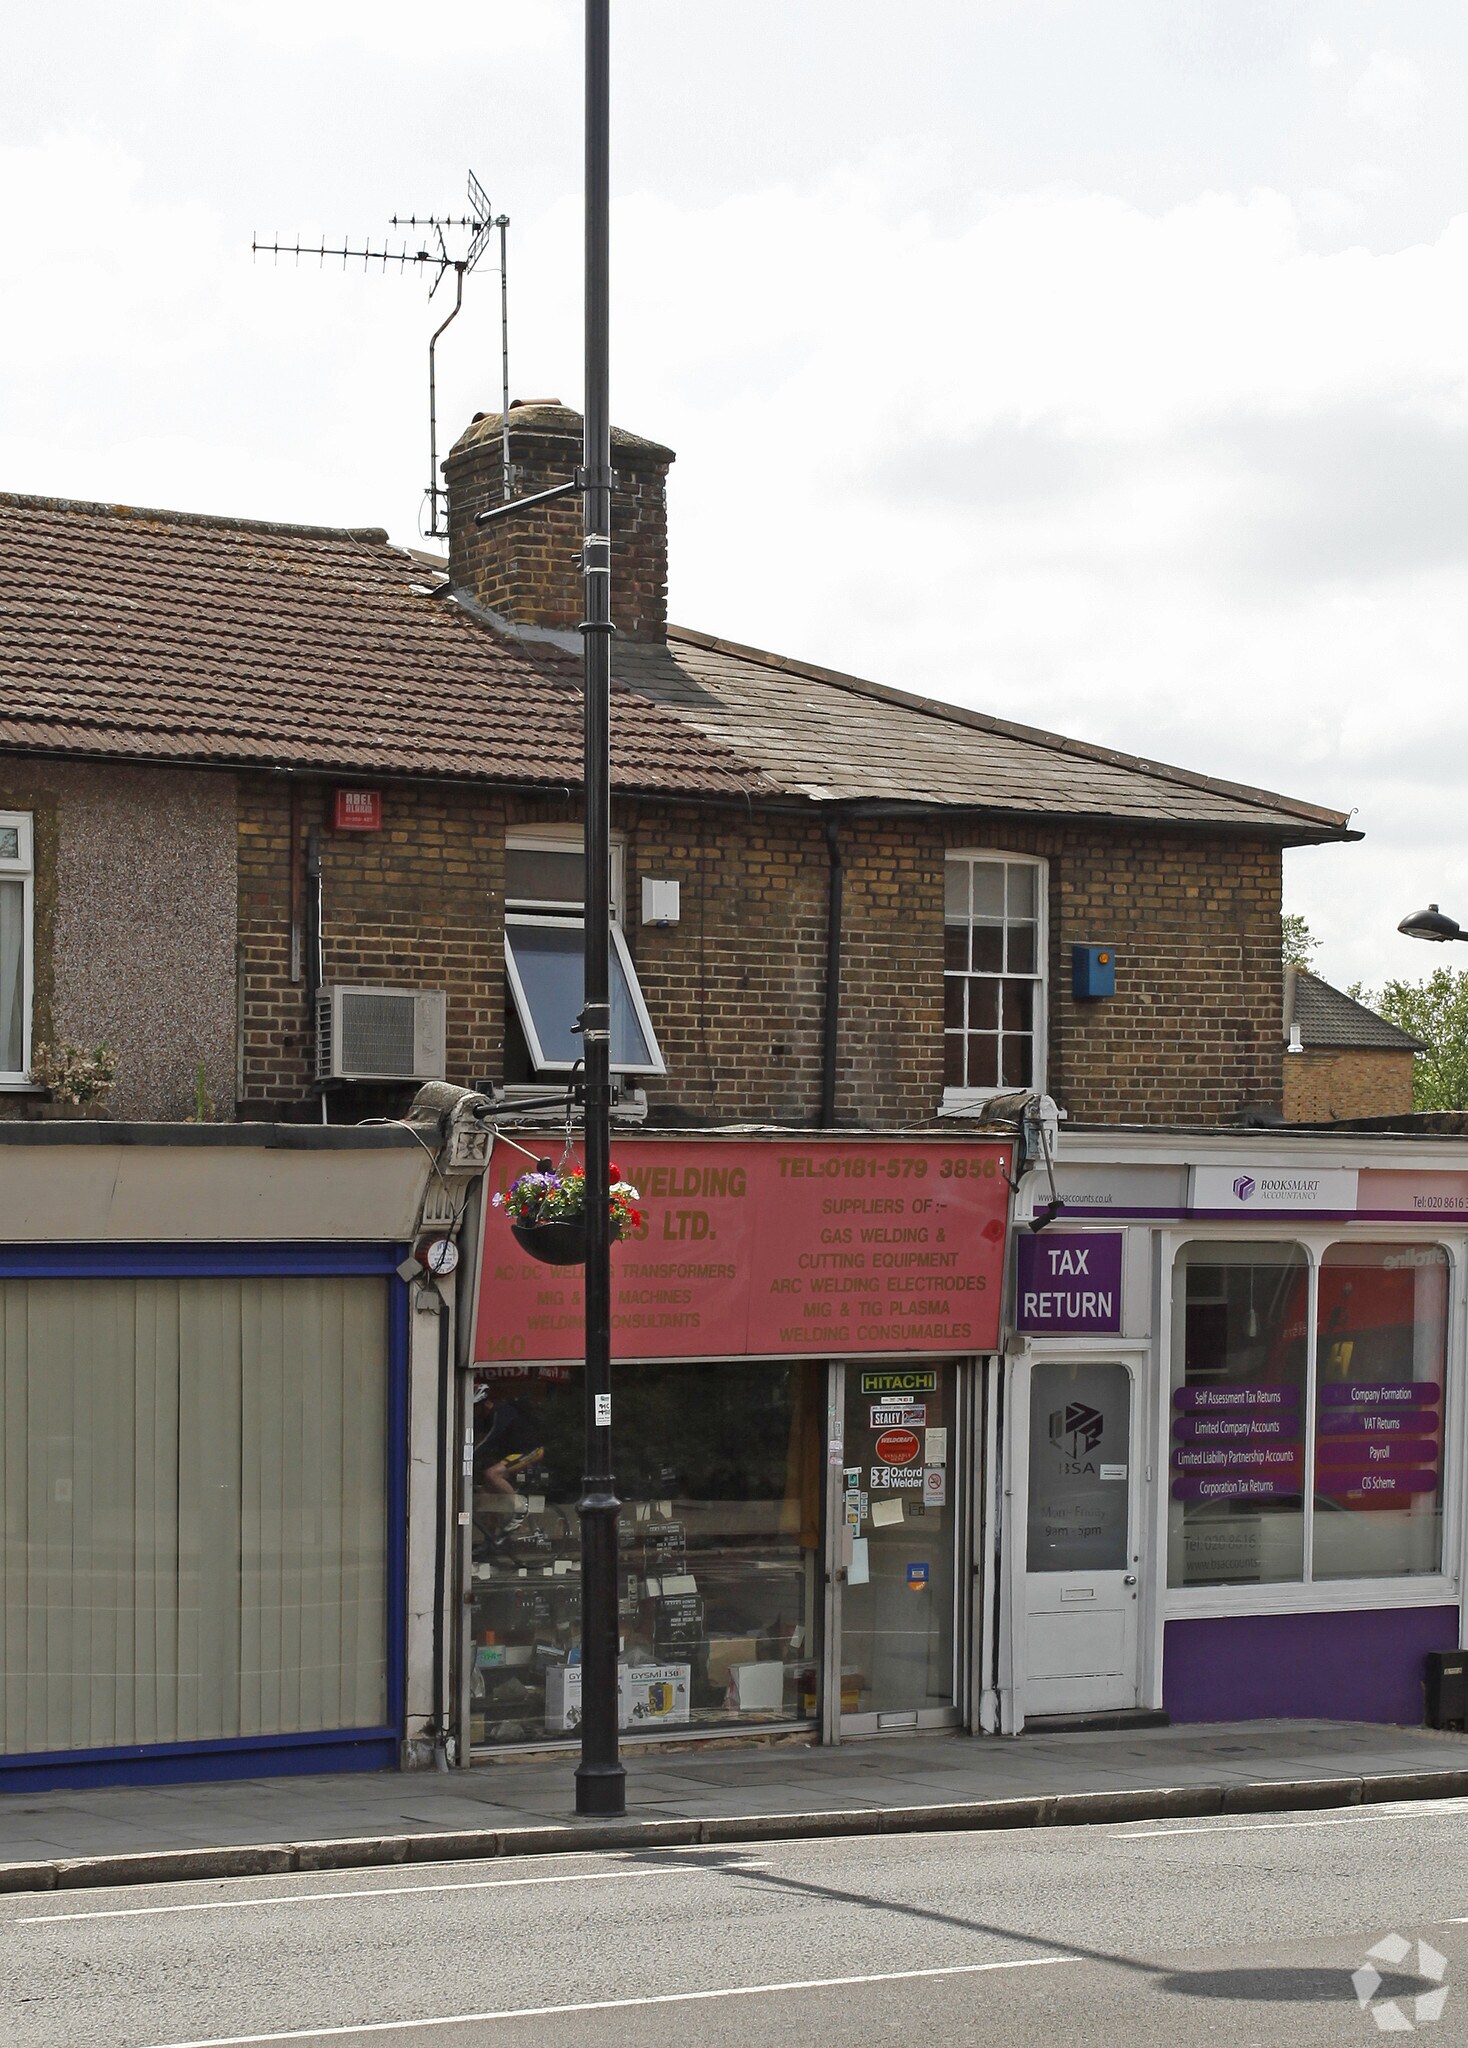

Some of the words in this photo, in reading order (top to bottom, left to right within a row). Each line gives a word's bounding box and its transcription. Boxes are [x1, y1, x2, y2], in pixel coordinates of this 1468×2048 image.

[346, 793, 372, 805] ABEL
[346, 804, 372, 814] ALARM
[940, 1158, 996, 1179] 3856
[627, 1167, 747, 1198] WELDING
[1261, 1180, 1320, 1190] BOOKSMART
[1038, 1192, 1112, 1204] wwwbsaccounts.co.uk
[1261, 1191, 1318, 1200] ACCOUNTANCY
[822, 1198, 904, 1214] SUPPLIERS
[664, 1210, 716, 1240] LTD.
[820, 1228, 852, 1244] GAS
[860, 1227, 928, 1242] WELDING
[936, 1228, 946, 1242] &
[798, 1253, 864, 1269] CUTTING
[873, 1252, 959, 1268] EQUIPMENT
[1048, 1249, 1090, 1276] TAX
[495, 1264, 542, 1280] AC/DC
[622, 1263, 736, 1279] TRANSFORMERS
[770, 1278, 802, 1294] ARC
[810, 1278, 880, 1293] WELDING
[887, 1276, 986, 1292] ELECTRODES
[537, 1290, 564, 1306] MIG
[570, 1291, 580, 1306] &
[618, 1289, 692, 1305] MACHINES
[1024, 1291, 1112, 1318] RETURN
[803, 1302, 832, 1318] MIG
[840, 1304, 850, 1317] &
[858, 1302, 882, 1316] TIG
[889, 1300, 950, 1316] PLASMA
[528, 1314, 586, 1330] WELDIN
[609, 1312, 700, 1329] ONSULTANTS
[779, 1326, 850, 1342] WELDING
[856, 1323, 972, 1340] CONSUMABLES
[865, 1374, 933, 1390] HITACHI
[1195, 1392, 1208, 1404] Self
[1208, 1391, 1245, 1404] Assessment
[1245, 1391, 1256, 1403] Tax
[1257, 1390, 1281, 1403] Returns
[1351, 1388, 1380, 1403] Company
[1381, 1387, 1412, 1400] Formation
[876, 1412, 900, 1424] SEALEY
[1364, 1417, 1376, 1430] VAT
[1377, 1417, 1400, 1430] Returns
[1195, 1421, 1219, 1434] Limited
[1220, 1421, 1250, 1436] Company
[1250, 1420, 1280, 1433] Accounts
[881, 1436, 914, 1444] WELDCRAFT
[1178, 1451, 1202, 1465] Limited
[1203, 1450, 1228, 1466] Liability
[1228, 1450, 1264, 1465] Partnership
[1265, 1450, 1294, 1462] Accounts
[1369, 1445, 1390, 1461] Payroll
[891, 1466, 923, 1477] Oxford
[1059, 1462, 1095, 1474] BSA
[891, 1478, 923, 1488] Welder
[1200, 1480, 1237, 1496] Corporation
[1238, 1480, 1249, 1492] Tax
[1250, 1479, 1274, 1492] Returns
[1362, 1477, 1372, 1490] CIS
[1373, 1476, 1396, 1489] Scheme
